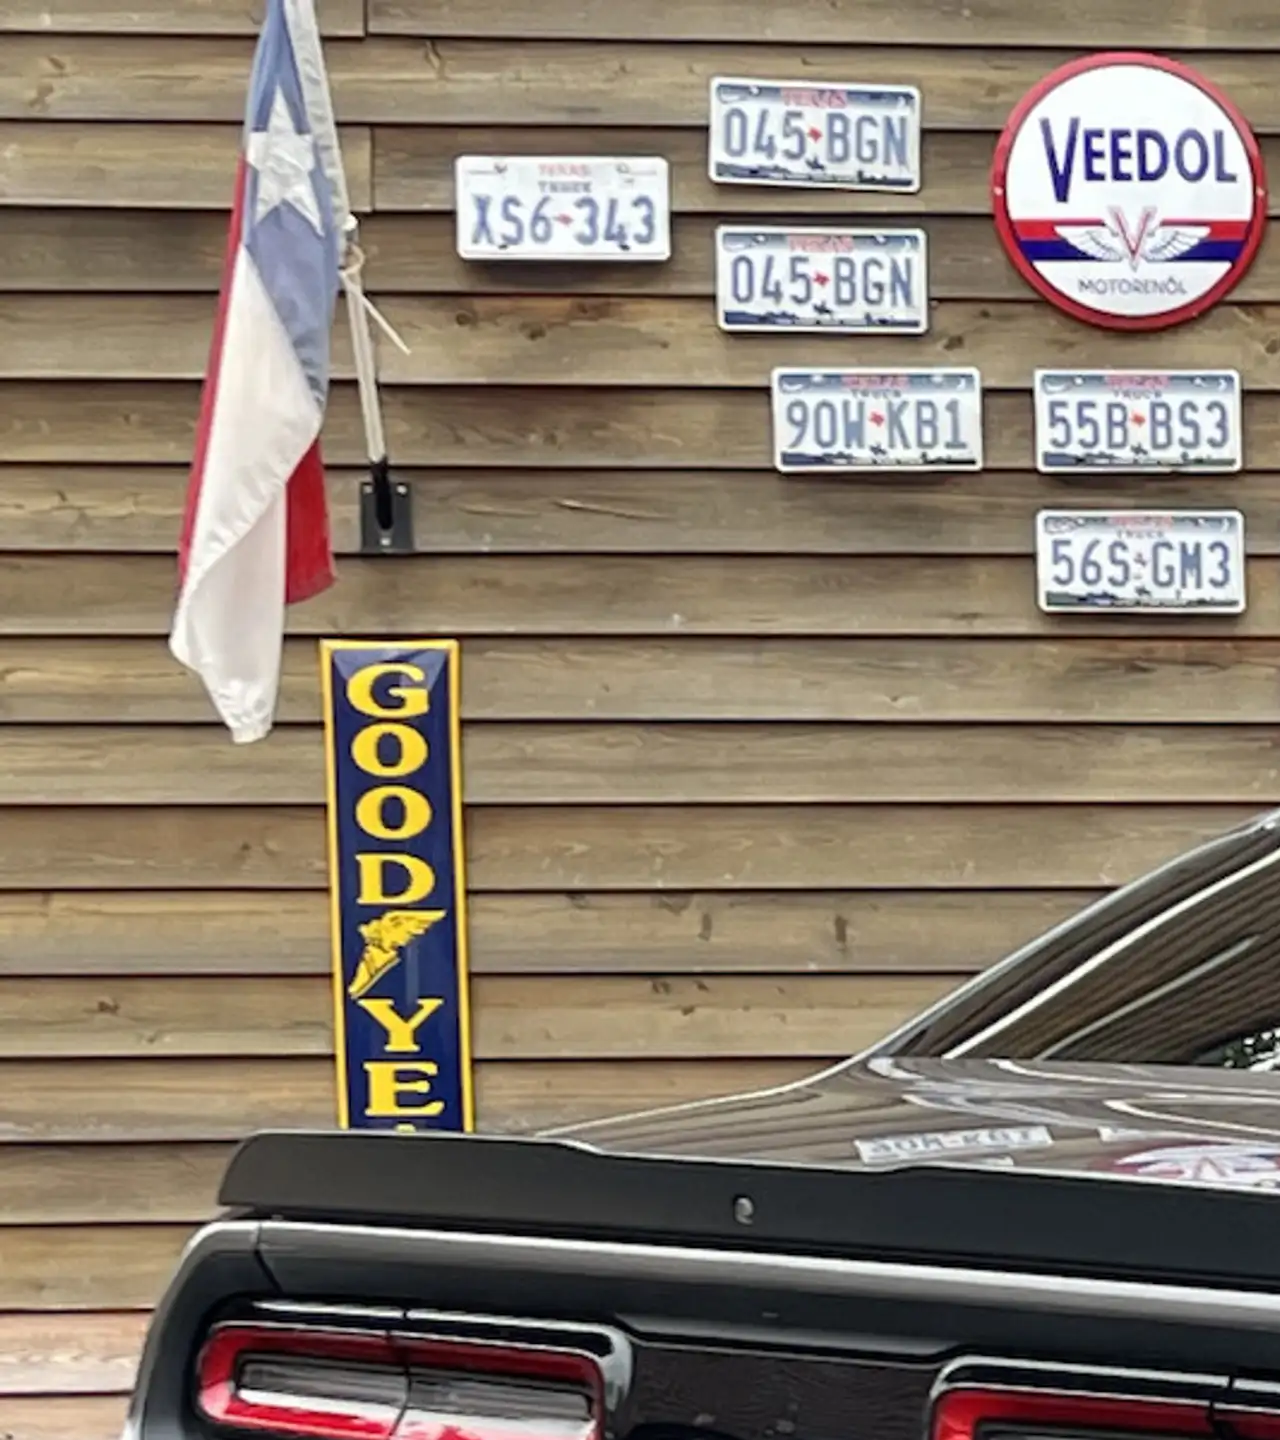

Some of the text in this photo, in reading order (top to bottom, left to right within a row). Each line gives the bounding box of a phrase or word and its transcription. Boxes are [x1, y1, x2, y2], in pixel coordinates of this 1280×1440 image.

[827, 113, 907, 165] BGN
[1039, 117, 1238, 203] VEEDOL
[471, 195, 655, 245] XS6 343
[834, 257, 913, 307] BGN
[887, 400, 967, 449] KB1
[1049, 400, 1229, 449] 55B BS3
[1051, 539, 1230, 589] 56S GM3
[346, 662, 446, 1132] GOODYE
